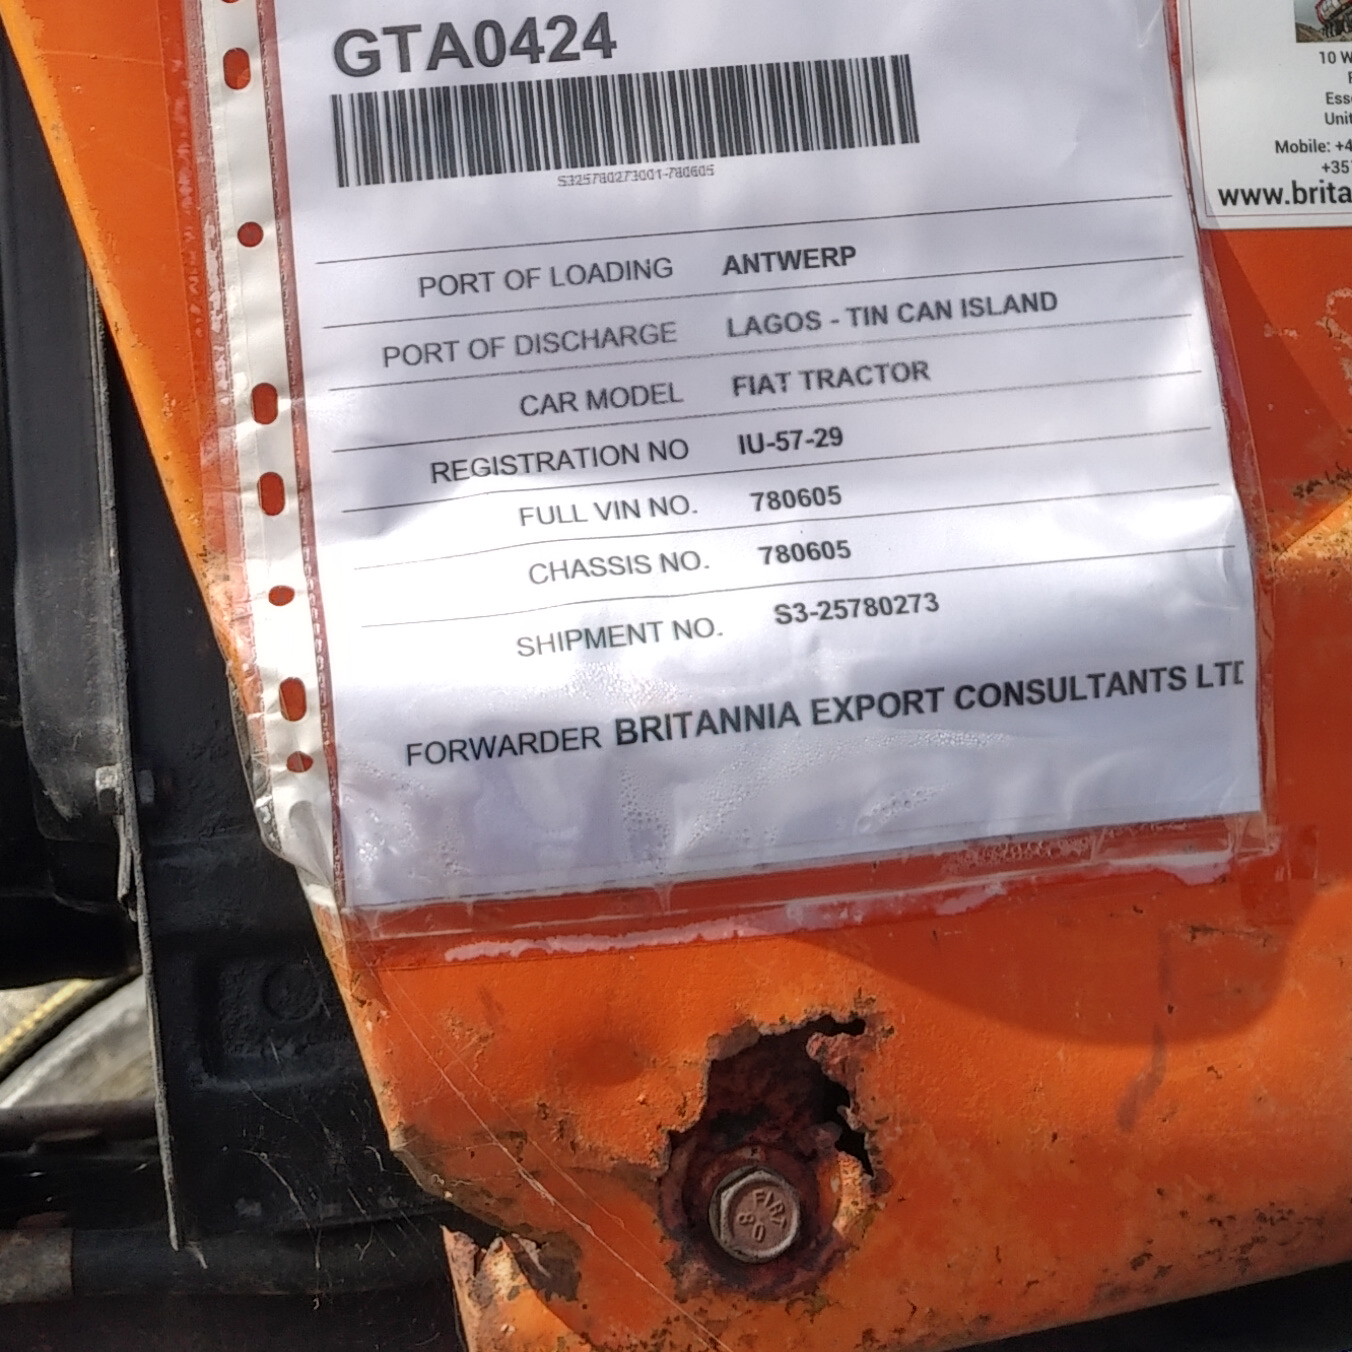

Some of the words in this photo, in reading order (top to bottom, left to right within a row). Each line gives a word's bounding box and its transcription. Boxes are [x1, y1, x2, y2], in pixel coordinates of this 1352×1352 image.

[334, 12, 617, 77] GTA0424
[1319, 51, 1336, 64] 10
[1275, 139, 1330, 154] Mobile:
[419, 271, 496, 298] PORT
[504, 267, 541, 291] OF
[551, 257, 673, 287] LOADING
[722, 246, 856, 275] ANTWERP
[383, 340, 460, 368] PORT
[468, 336, 505, 360] OF
[515, 320, 677, 357] DISCHARGE
[727, 311, 821, 337] LAGOS
[846, 305, 888, 327] TIN
[897, 300, 952, 323] CAN
[961, 291, 1057, 318] ISLAND
[520, 392, 578, 416] CAR
[586, 382, 683, 410] MODEL
[733, 372, 791, 396] FIAT
[799, 361, 930, 390] TRACTOR
[430, 443, 640, 484] REGISTRATION
[648, 439, 688, 461] NO
[739, 427, 843, 455] IU-57-29
[519, 504, 589, 526] FULL
[594, 499, 641, 521] VIN
[649, 494, 697, 518] NO.
[750, 485, 841, 511] 780605
[529, 555, 652, 584] CHASSIS
[660, 549, 709, 574] NO.
[758, 540, 851, 564] 780605
[517, 621, 663, 656] SHIPMENT
[672, 616, 722, 642] NO.
[775, 592, 939, 624] S3-25780273
[407, 727, 602, 766] FORWARDER
[615, 701, 801, 749] BRITANNIA
[811, 686, 945, 725] EXPORT
[954, 666, 1186, 710] CONSULTANTS
